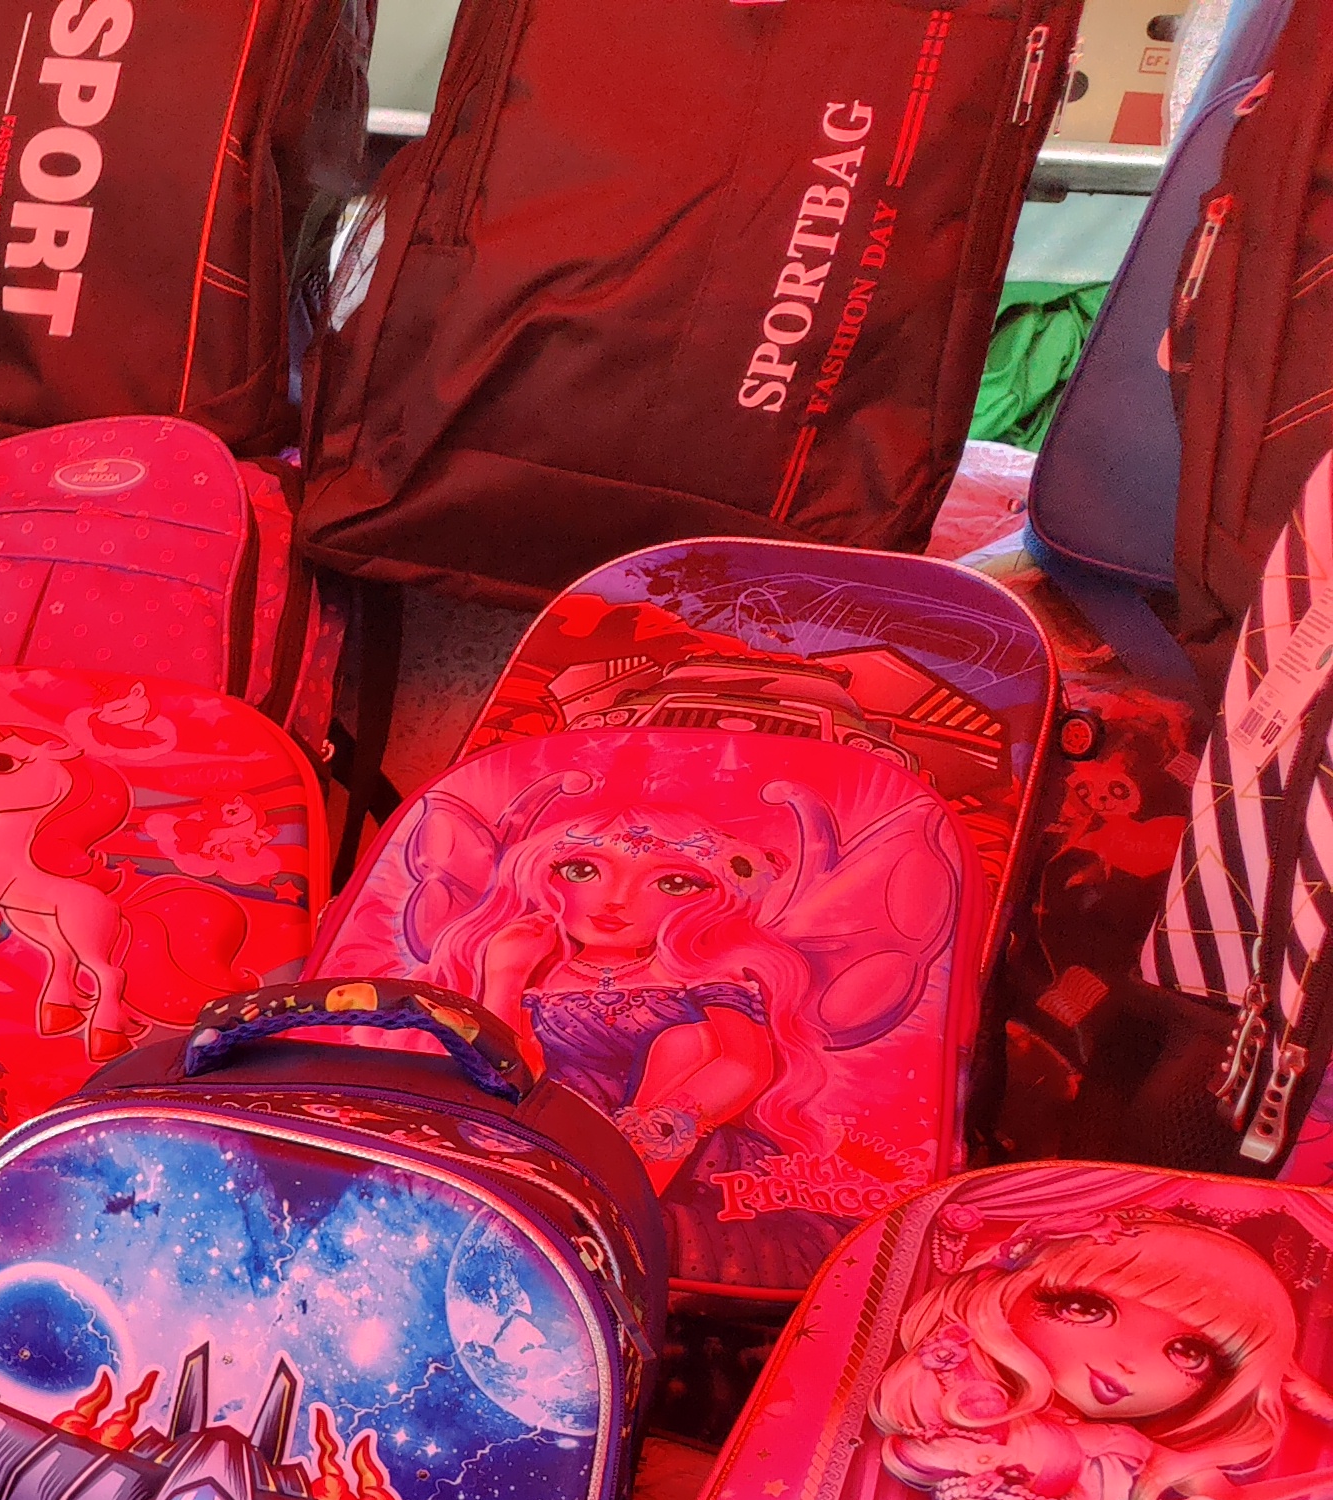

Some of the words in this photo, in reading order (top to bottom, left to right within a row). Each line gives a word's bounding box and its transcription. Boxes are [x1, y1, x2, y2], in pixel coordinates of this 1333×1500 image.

[2, 0, 134, 338] SPORT
[738, 98, 874, 413] SPORTBAG
[806, 276, 877, 414] FASHION
[859, 199, 898, 270] DAY
